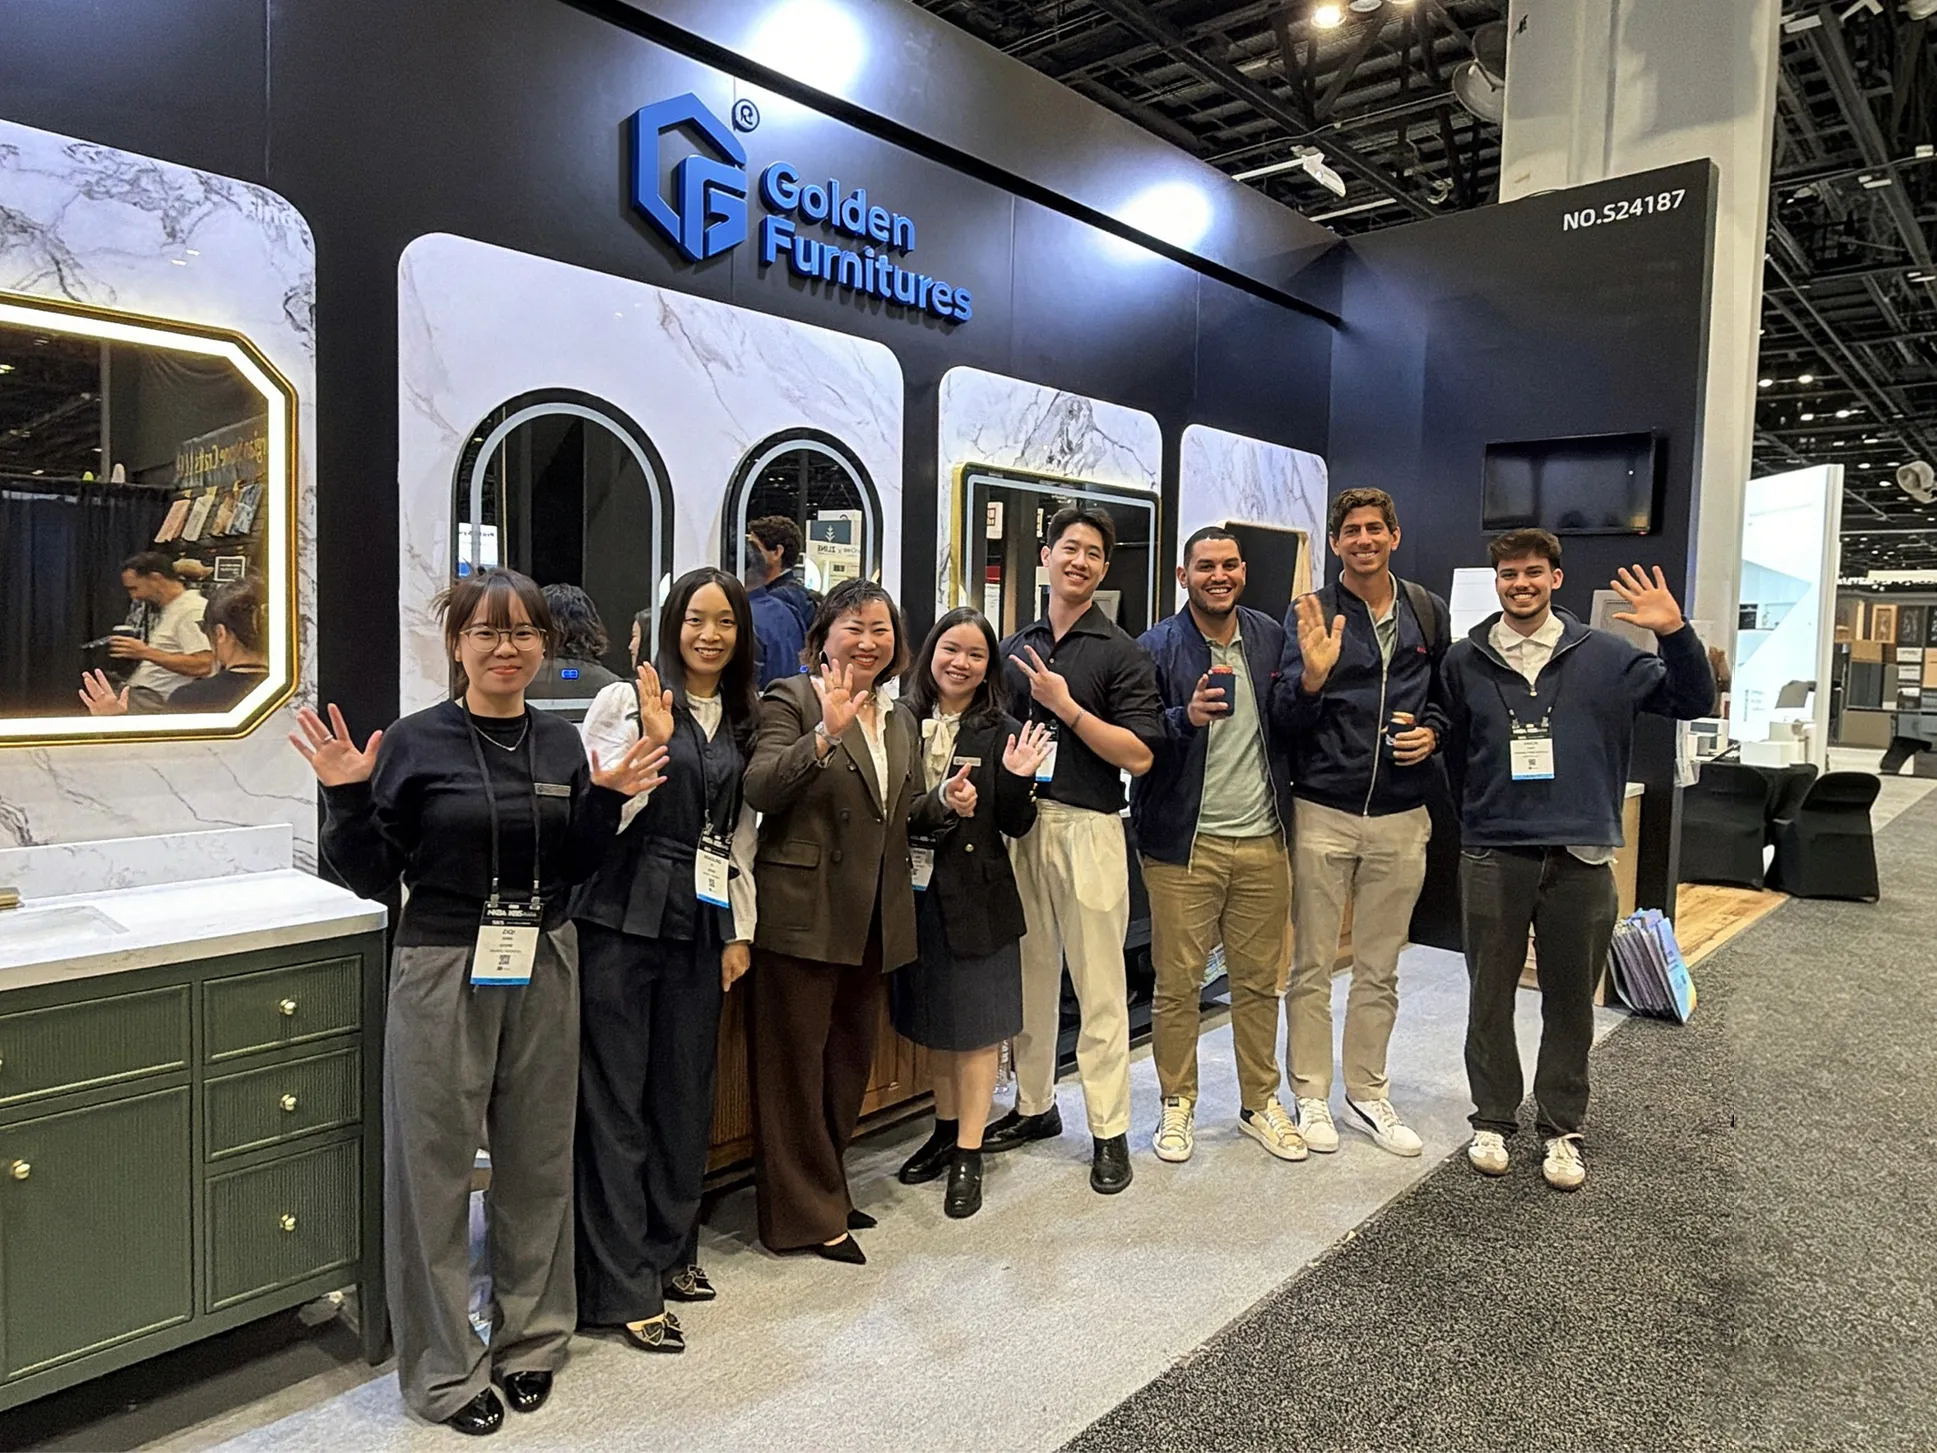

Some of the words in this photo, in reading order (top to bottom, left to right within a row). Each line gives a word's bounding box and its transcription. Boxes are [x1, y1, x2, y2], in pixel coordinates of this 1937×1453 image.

[759, 160, 915, 250] Golden
[1562, 188, 1686, 231] NO.S24187
[758, 213, 973, 324] Furnitures
